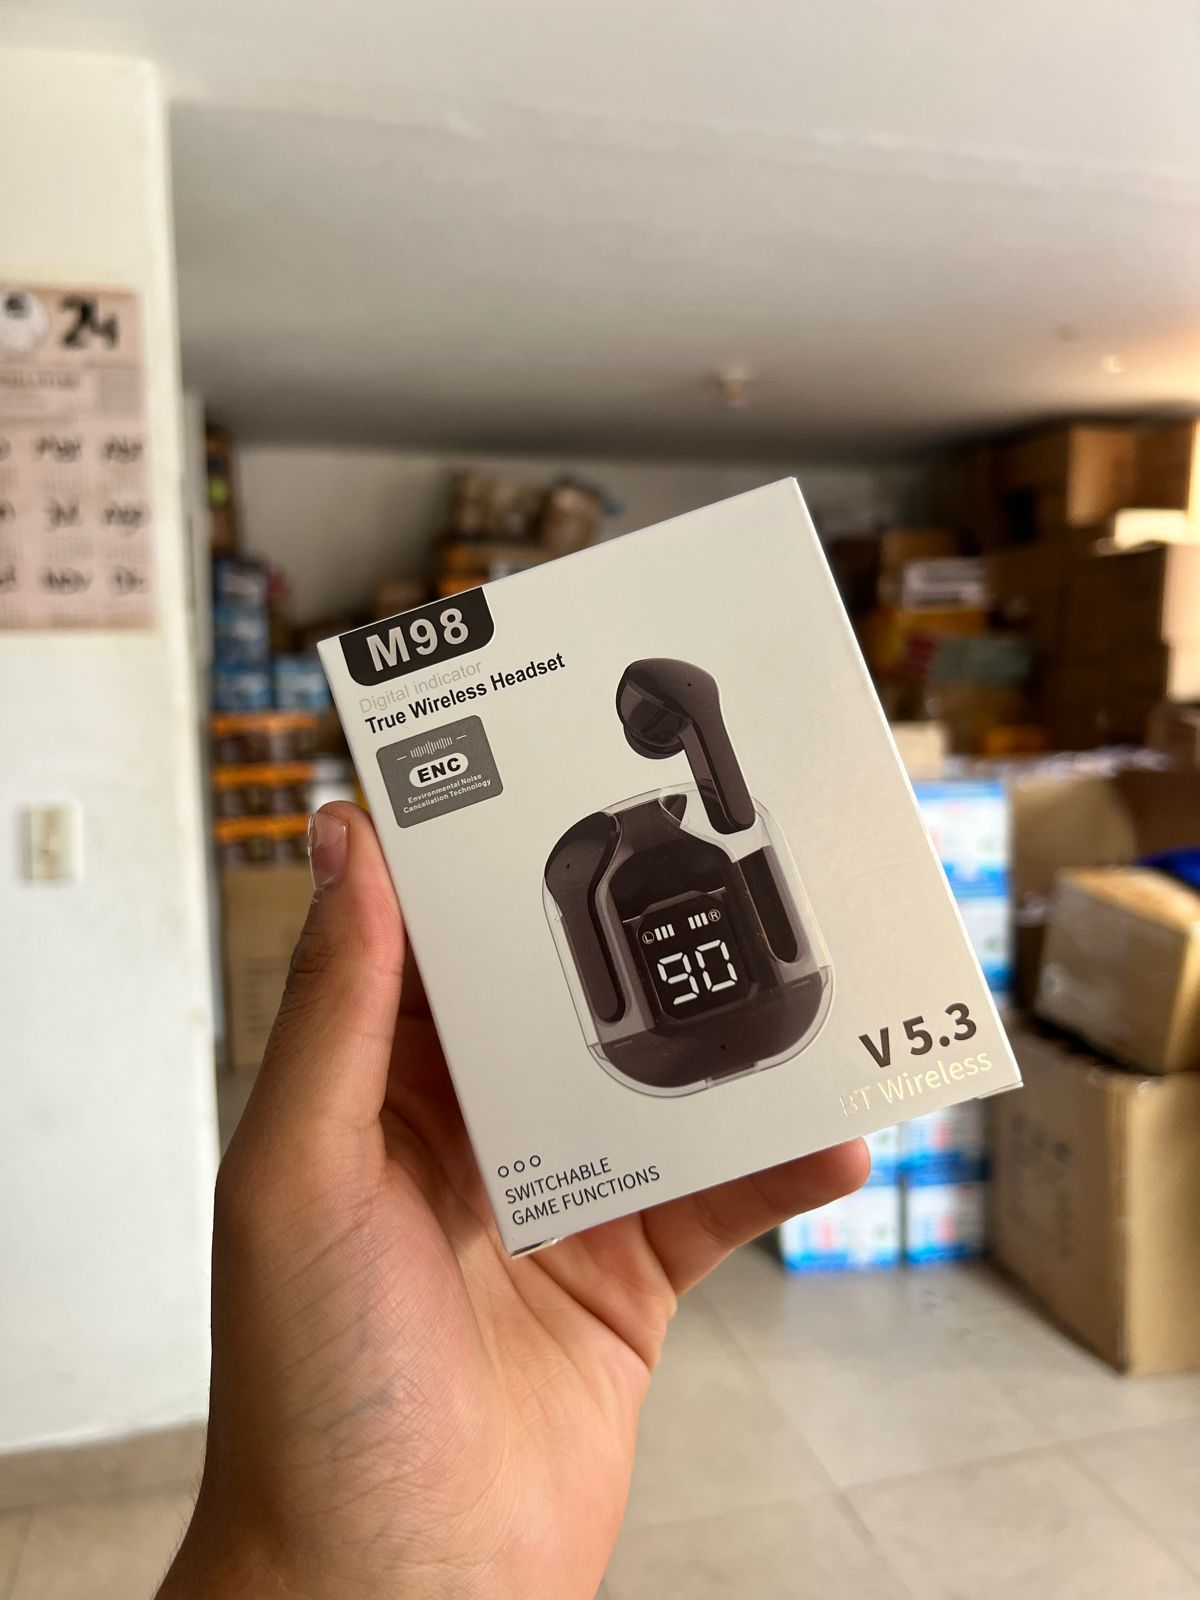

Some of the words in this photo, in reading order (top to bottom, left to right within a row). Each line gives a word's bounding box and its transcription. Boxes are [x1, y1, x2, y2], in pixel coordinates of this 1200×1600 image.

[366, 608, 469, 672] M98
[358, 685, 410, 713] Digital
[412, 661, 482, 695] indicator
[365, 711, 407, 734] True
[408, 683, 487, 718] Wireless
[490, 652, 566, 691] Headset
[407, 781, 460, 804] Environmental
[461, 774, 482, 785] Noise
[417, 757, 461, 783] ENC
[403, 794, 449, 814] Cancellation
[449, 779, 491, 798] Technology
[657, 939, 738, 1005] 90
[858, 1026, 891, 1068] V
[902, 1002, 977, 1056] 5.3
[877, 1052, 993, 1104] Wireless
[505, 1157, 612, 1205] SWITCHABLE
[512, 1198, 560, 1225] GAME
[561, 1165, 661, 1210] FUNCTIONS
